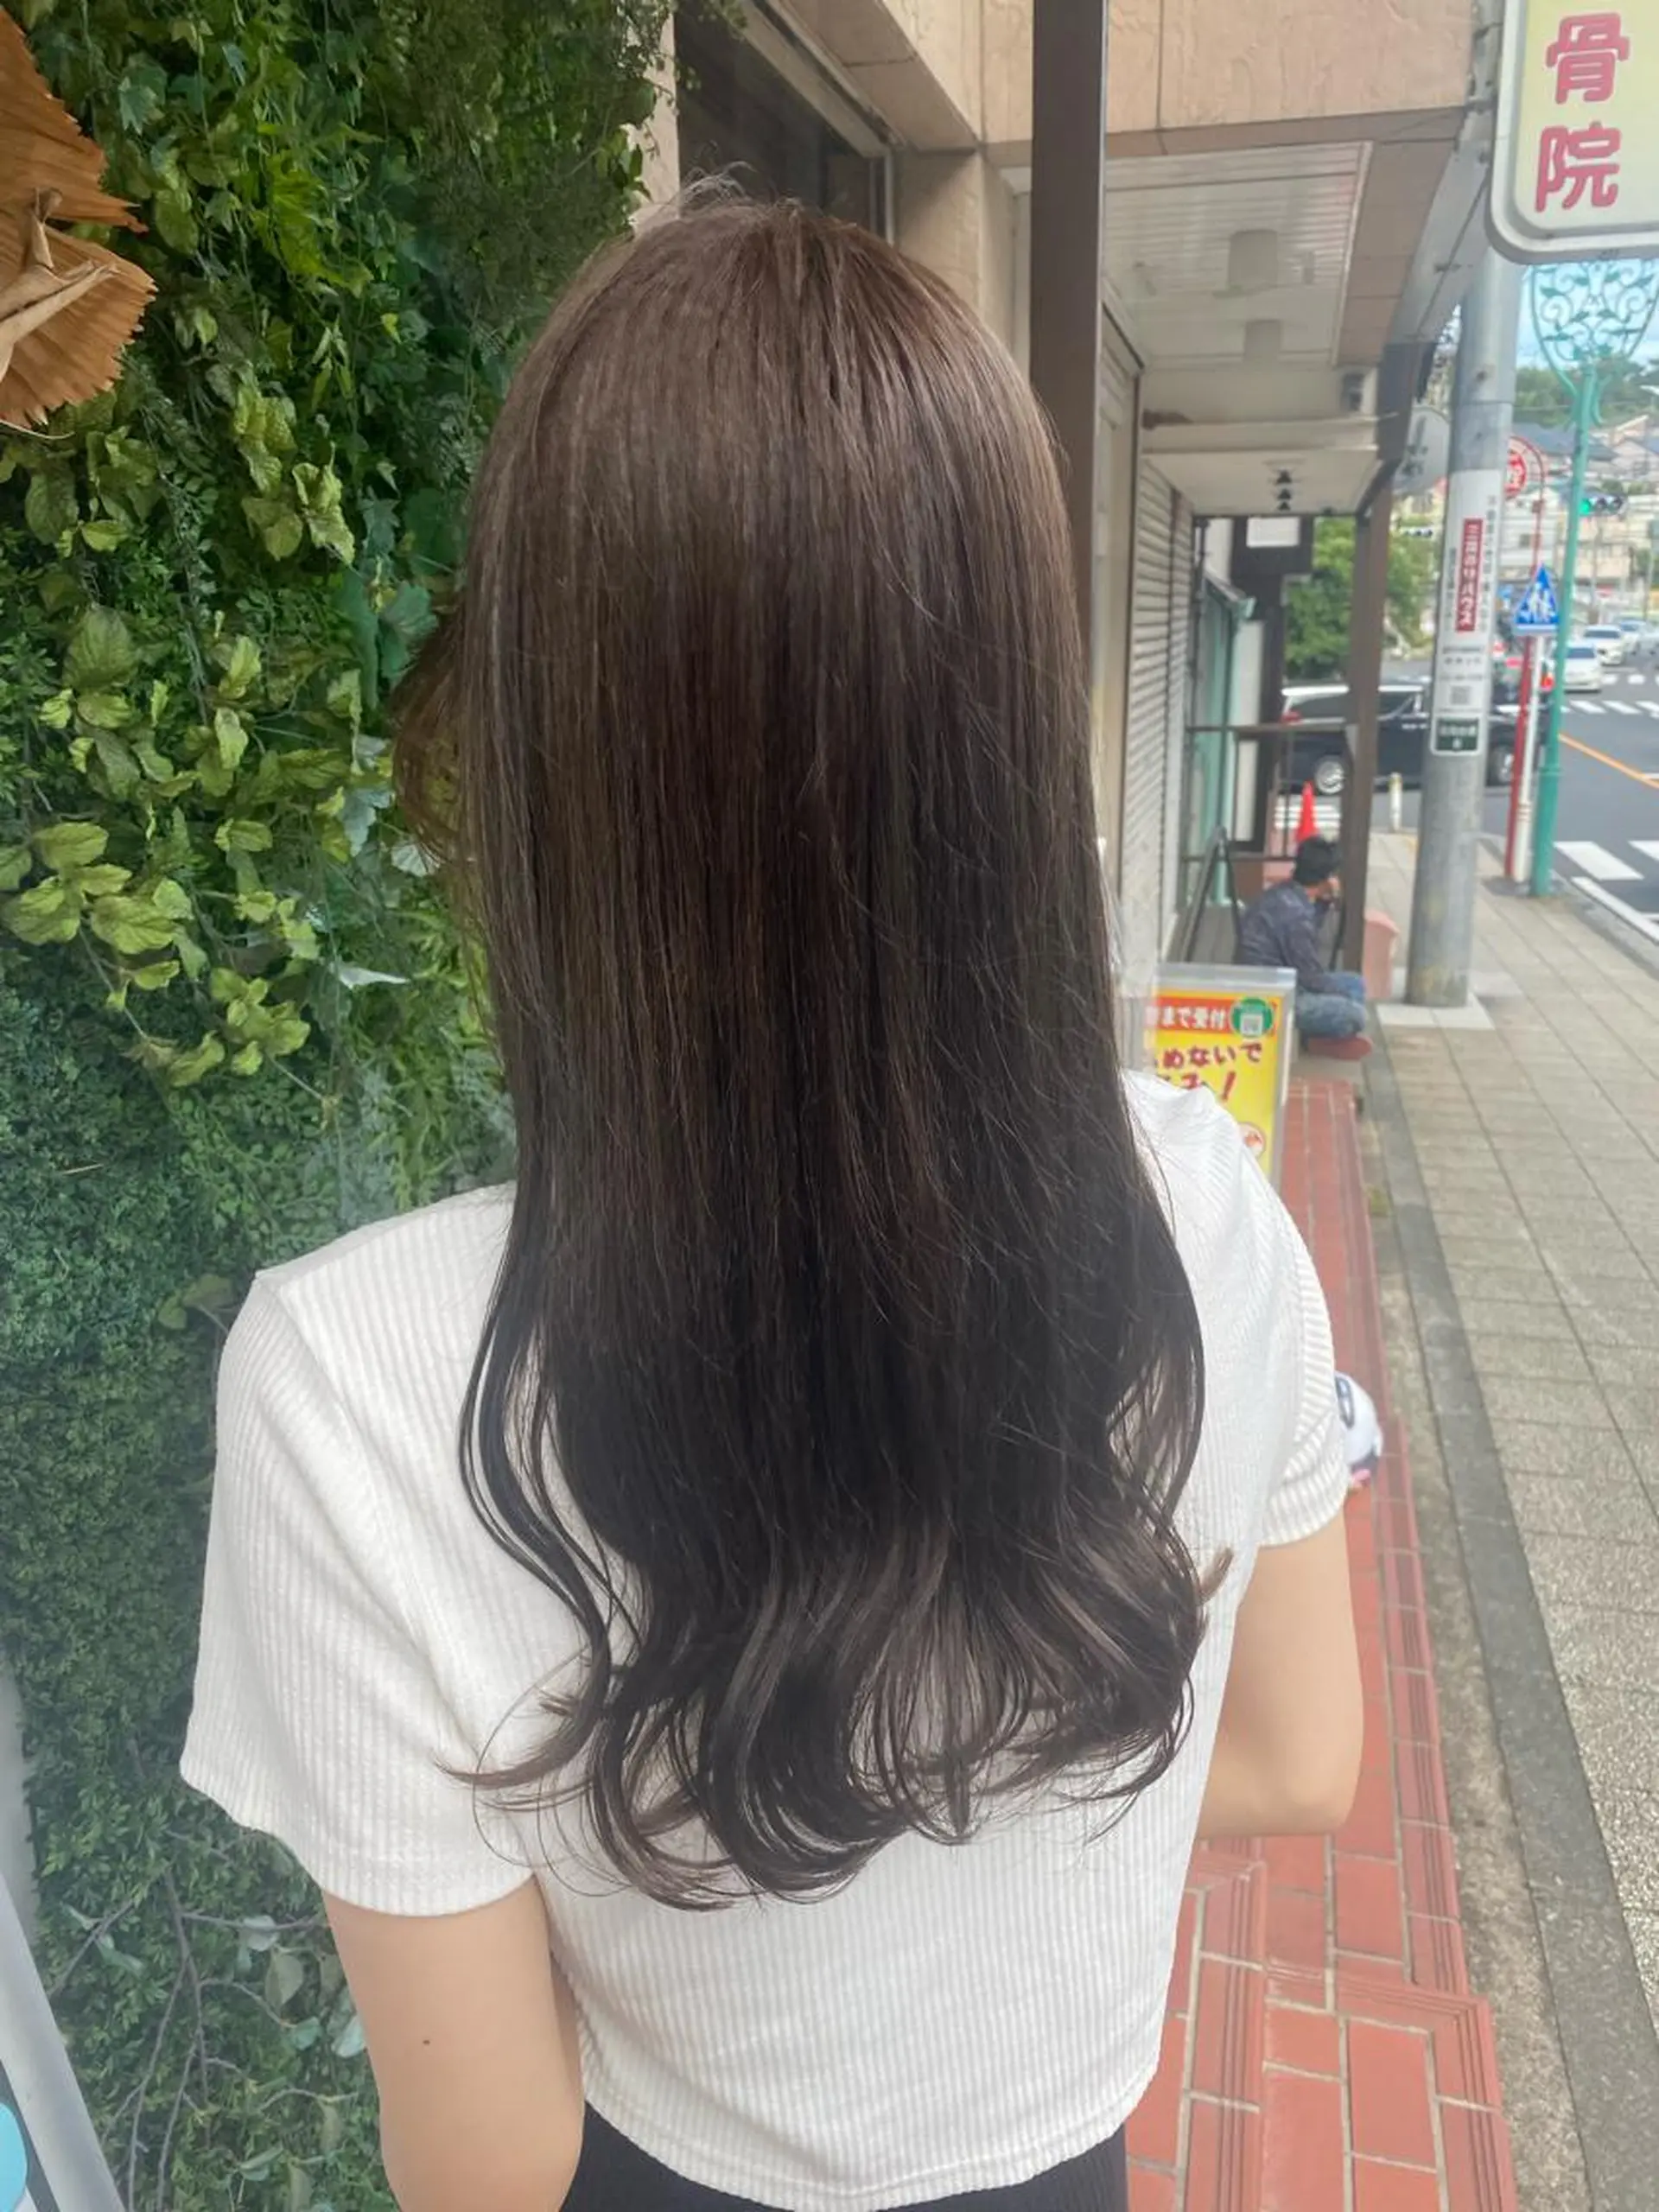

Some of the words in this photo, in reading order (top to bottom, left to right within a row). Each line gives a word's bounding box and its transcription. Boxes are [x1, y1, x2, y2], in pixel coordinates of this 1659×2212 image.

[1535, 12, 1630, 213] 骨院
[1154, 1043, 1262, 1069] めないで
